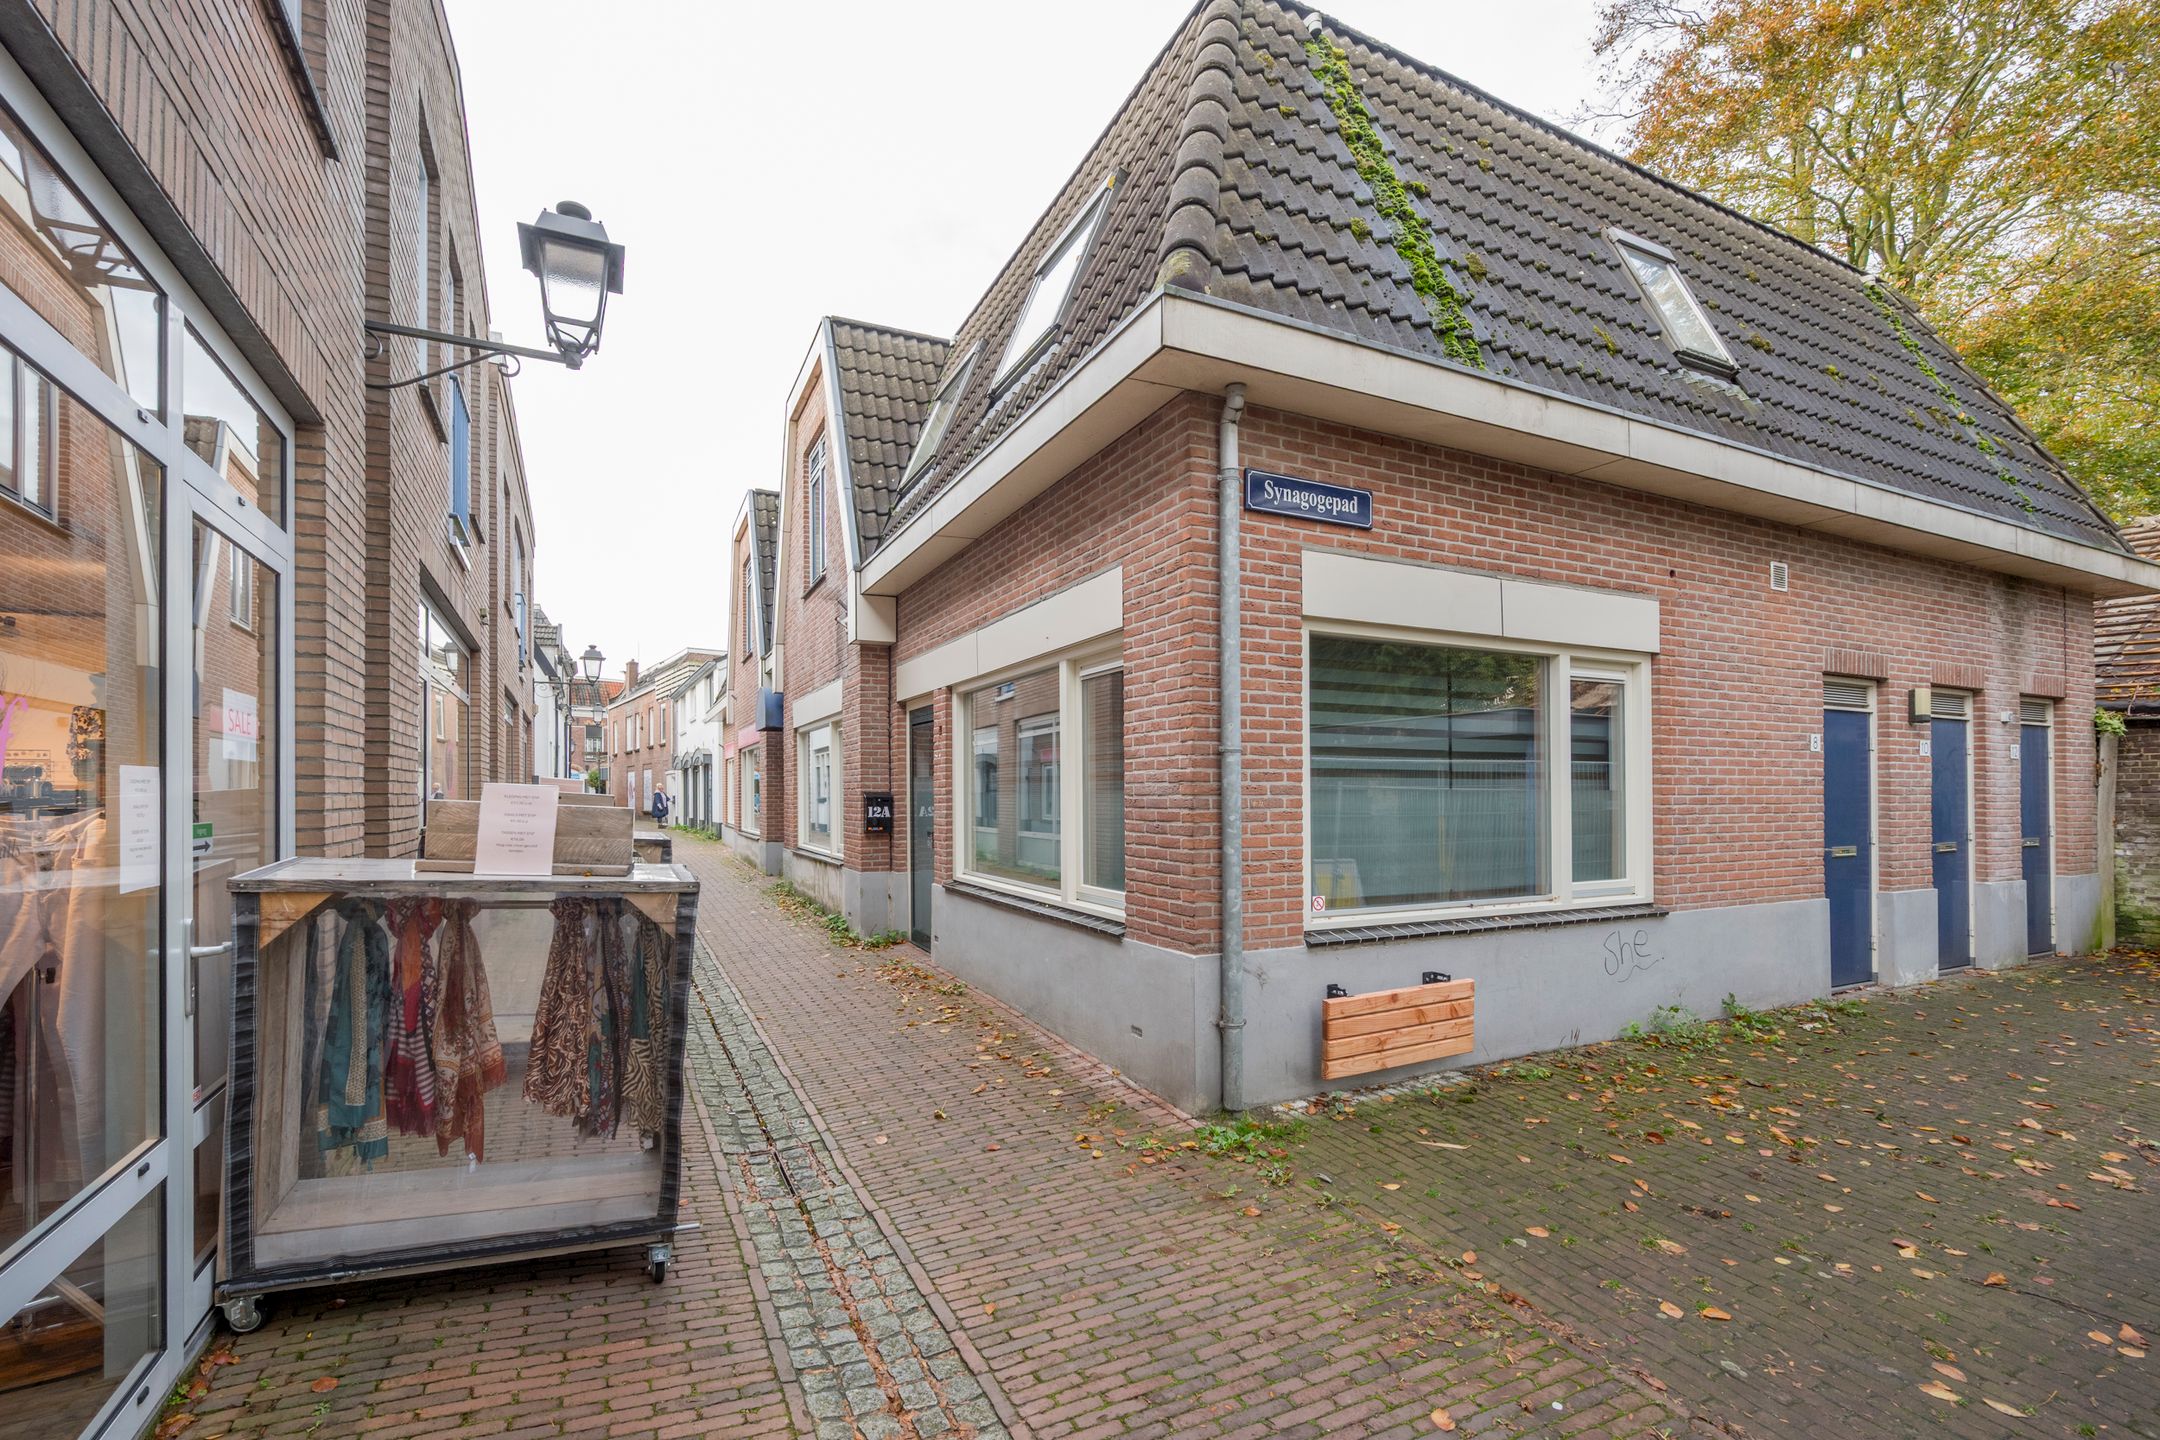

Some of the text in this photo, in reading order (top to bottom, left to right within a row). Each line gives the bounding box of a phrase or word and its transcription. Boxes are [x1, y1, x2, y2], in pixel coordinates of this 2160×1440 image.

[1264, 479, 1358, 516] Synagogepad
[228, 707, 251, 736] SALE
[1812, 736, 1819, 750] 8
[1921, 742, 1929, 754] 10
[867, 806, 891, 818] 12A
[1603, 929, 1652, 976] She
